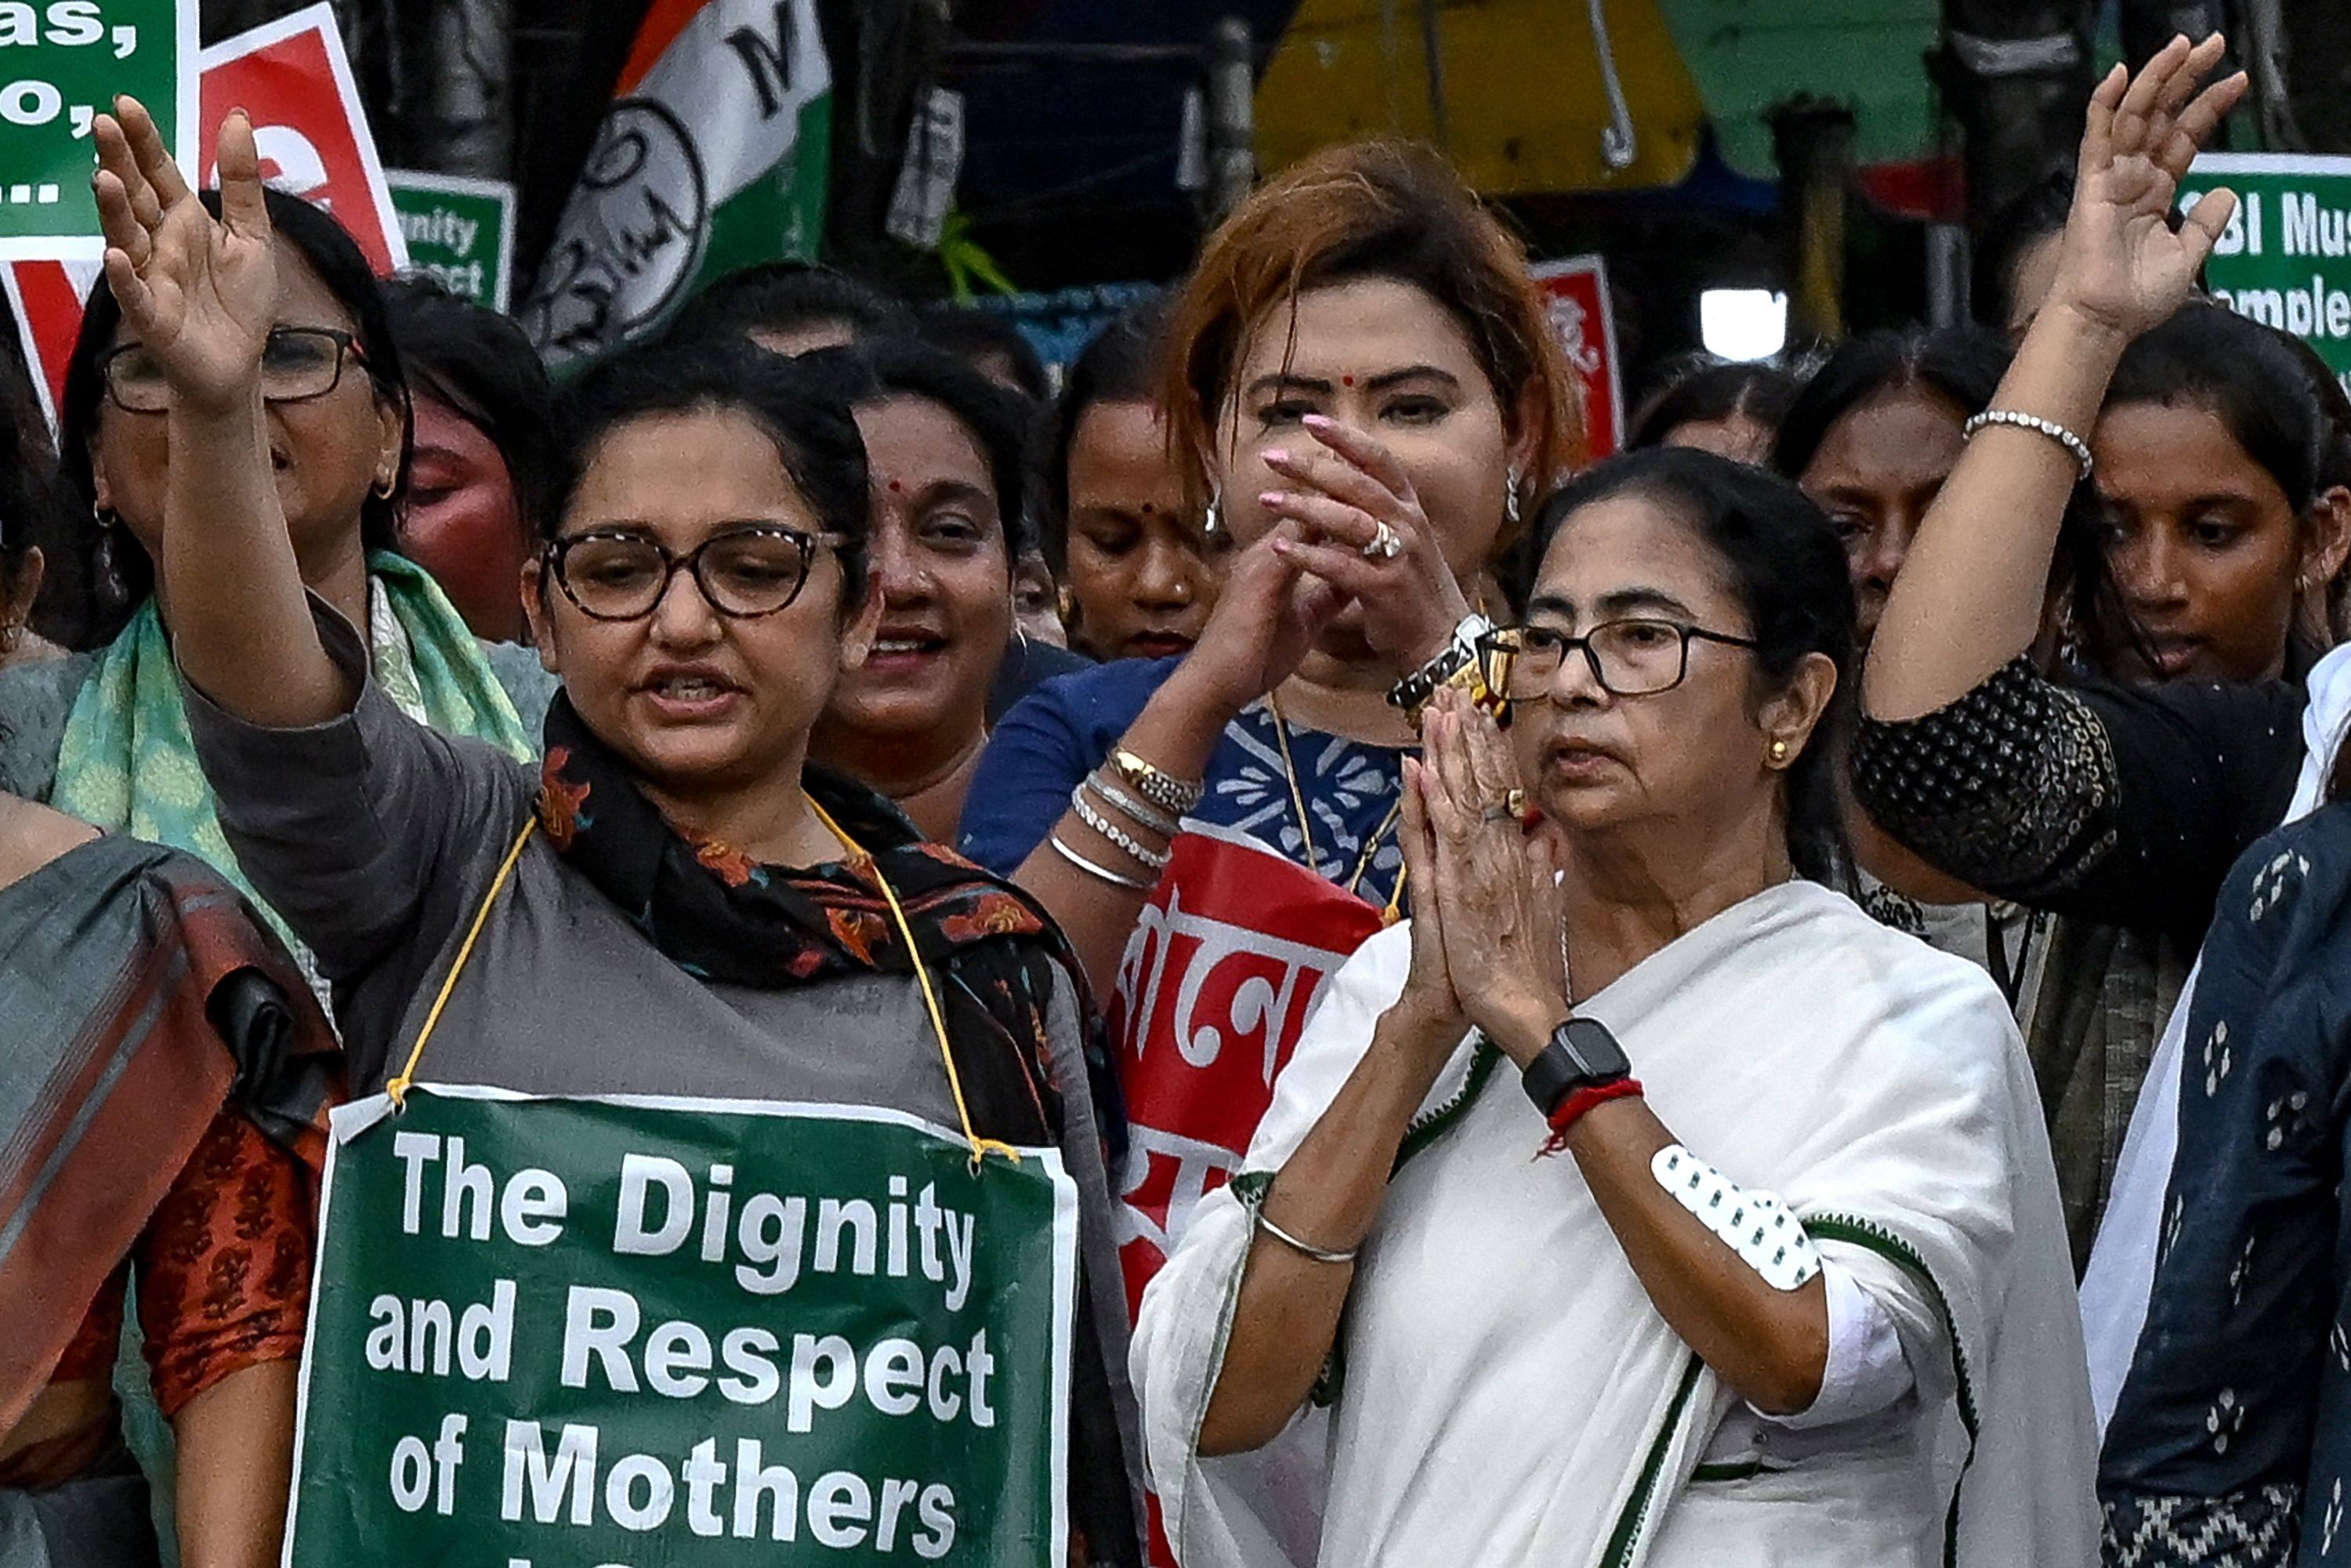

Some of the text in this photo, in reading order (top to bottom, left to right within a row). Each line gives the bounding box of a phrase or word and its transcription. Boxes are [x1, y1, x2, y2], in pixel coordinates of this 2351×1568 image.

[2177, 190, 2351, 257] BI Mu
[393, 1130, 567, 1247] The
[613, 1152, 976, 1312] Dignity
[365, 1278, 996, 1433] and Respect
[389, 1413, 956, 1559] of Mothers
